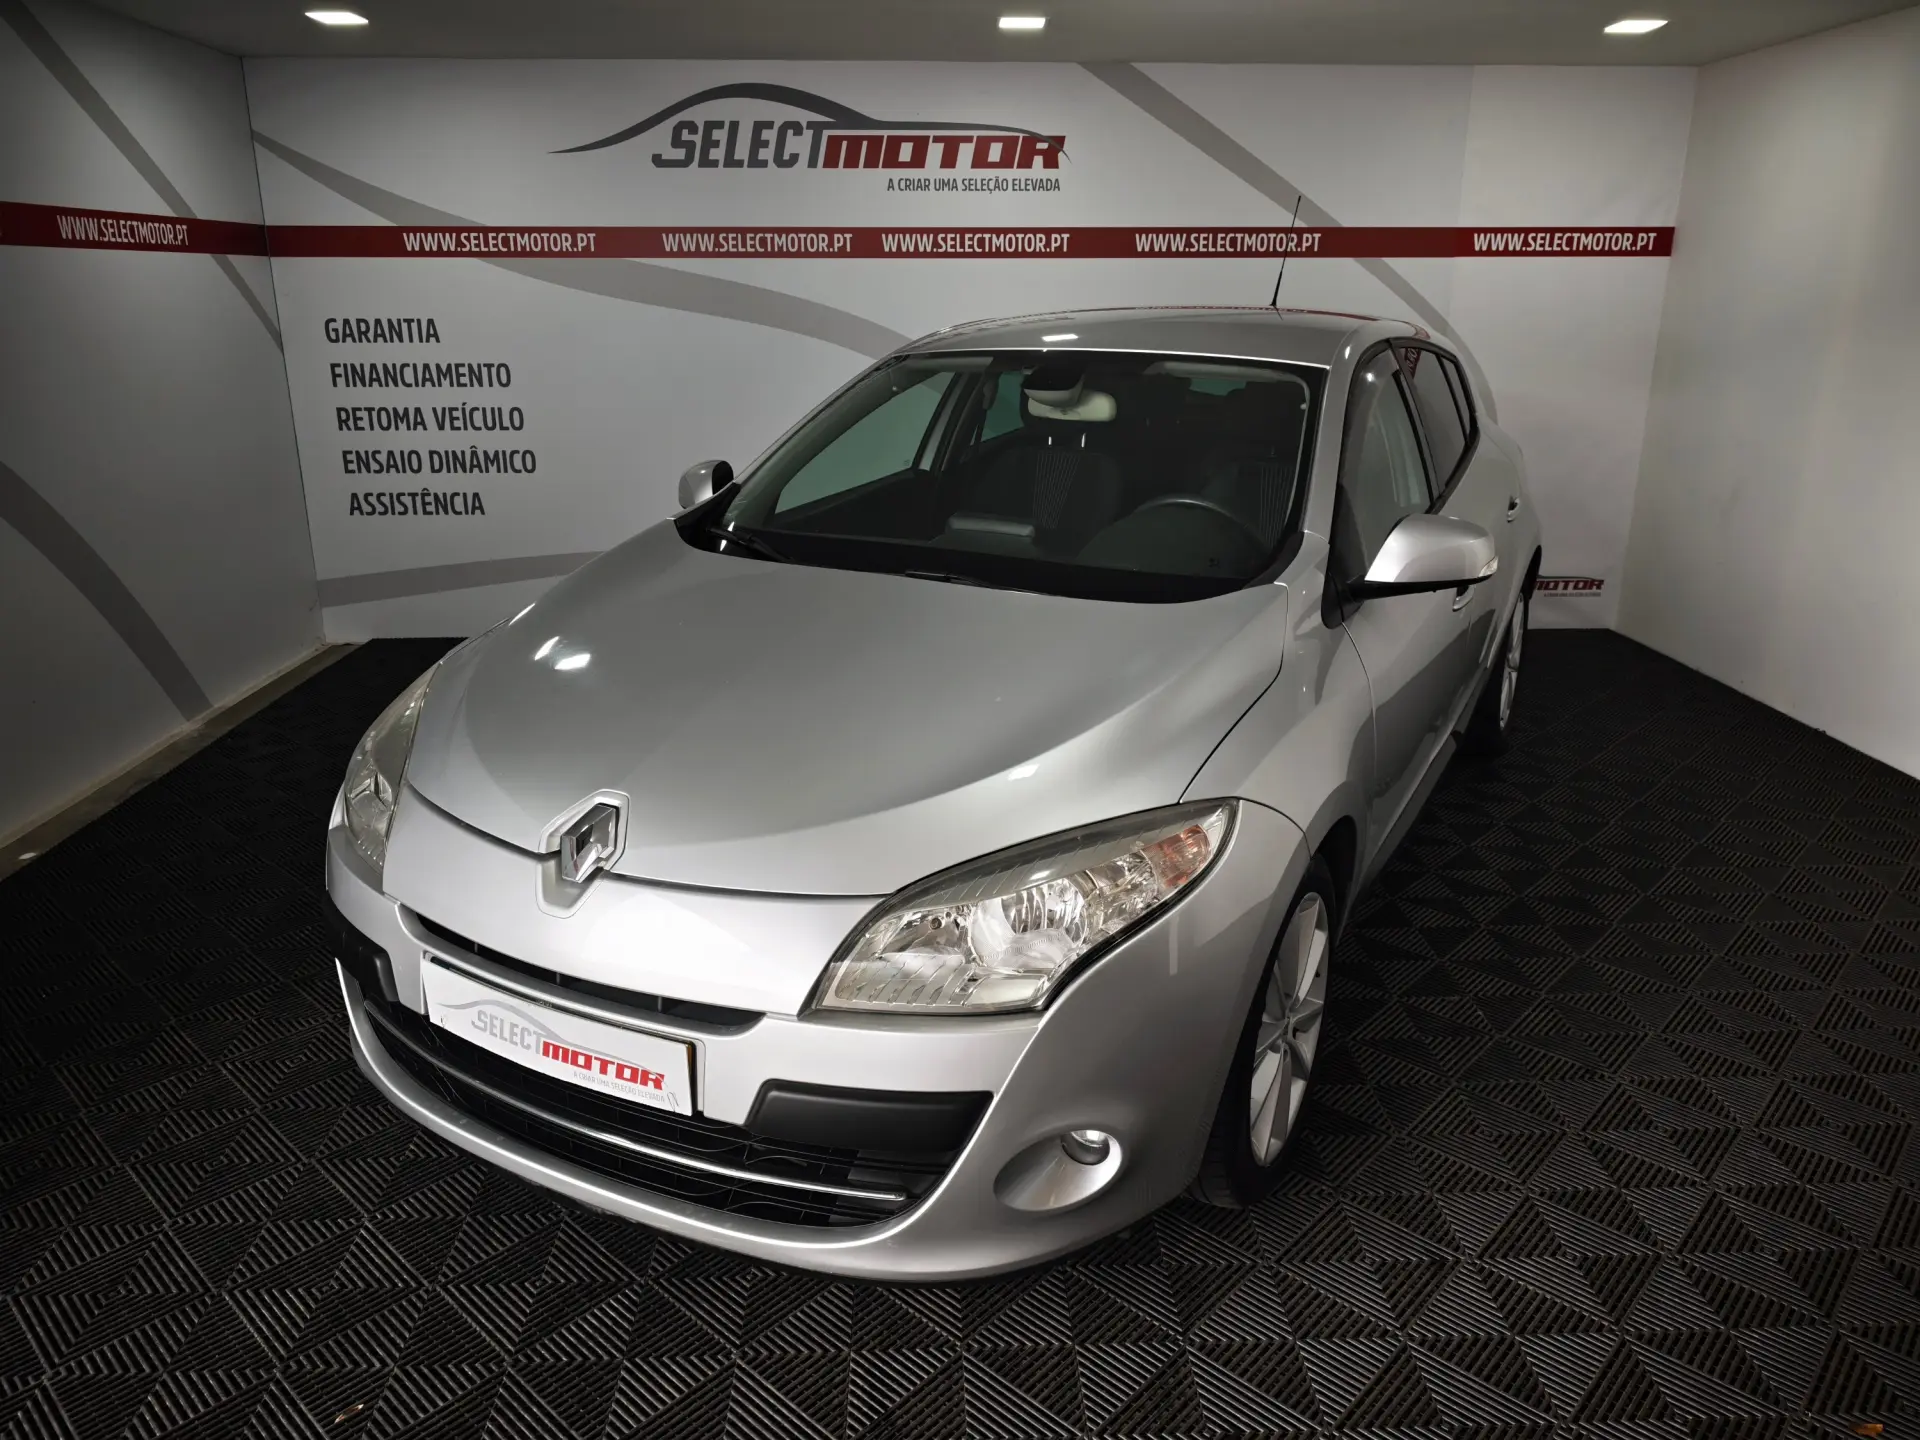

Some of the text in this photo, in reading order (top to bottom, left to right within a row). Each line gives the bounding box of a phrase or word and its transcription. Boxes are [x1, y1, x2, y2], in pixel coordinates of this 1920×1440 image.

[887, 175, 1061, 194] A CRIAR UMA SELEÇÃO ELEVADA
[57, 214, 189, 246] WWW.SELECTMOTOR.PT
[403, 232, 596, 252] WWW.SELECTMOTOR.PT
[662, 232, 853, 252] WWW.SELECTMOTOR.PT
[881, 232, 1070, 252] WWW.SELECTMOTOR.PT
[1135, 232, 1321, 252] WWW.SELECTMOTOR.PT
[1473, 232, 1657, 252] WWW.SELECTMOTOR.PT
[324, 318, 441, 344] GARANTIA
[330, 362, 512, 388] FINANCIAMENTO
[336, 402, 525, 431] RETOMA VEÍCULO
[342, 445, 537, 474] ENSAIO DINÂMICO
[349, 487, 486, 516] ASSISTÊNCIA
